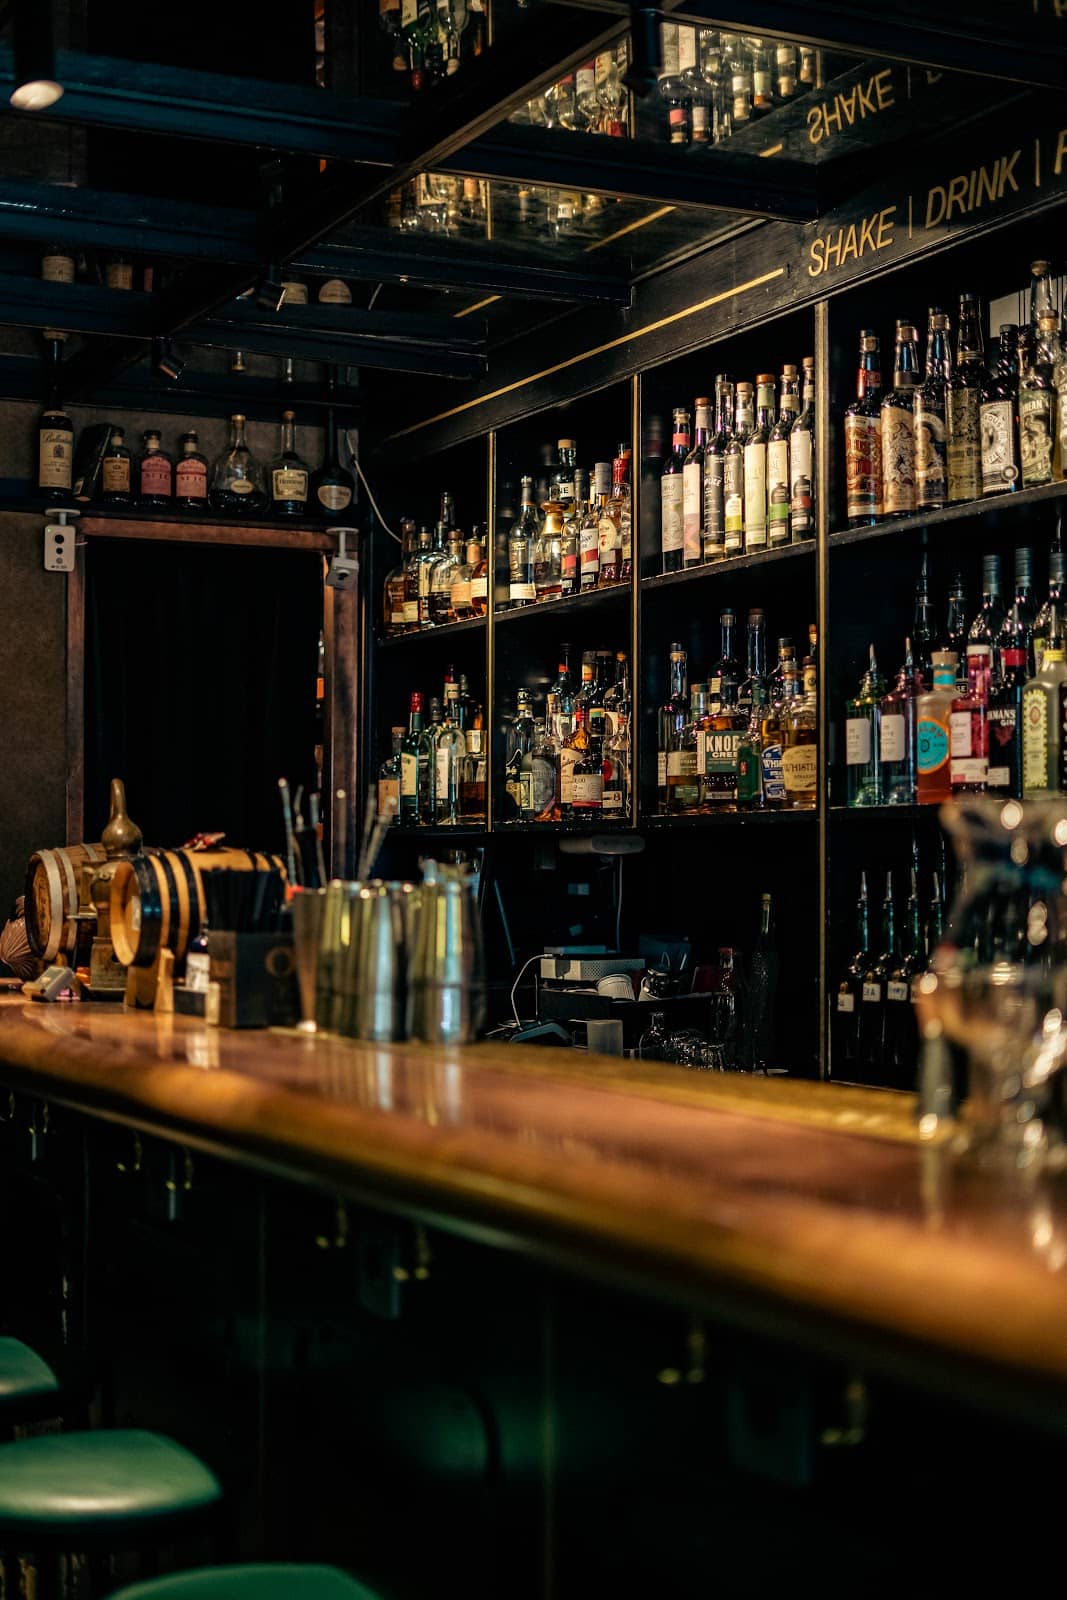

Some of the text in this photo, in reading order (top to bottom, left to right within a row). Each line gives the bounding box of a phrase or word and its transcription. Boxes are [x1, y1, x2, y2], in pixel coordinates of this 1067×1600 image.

[808, 205, 897, 277] SHAKE
[925, 150, 1022, 230] DRINK
[1000, 719, 1016, 727] GIN
